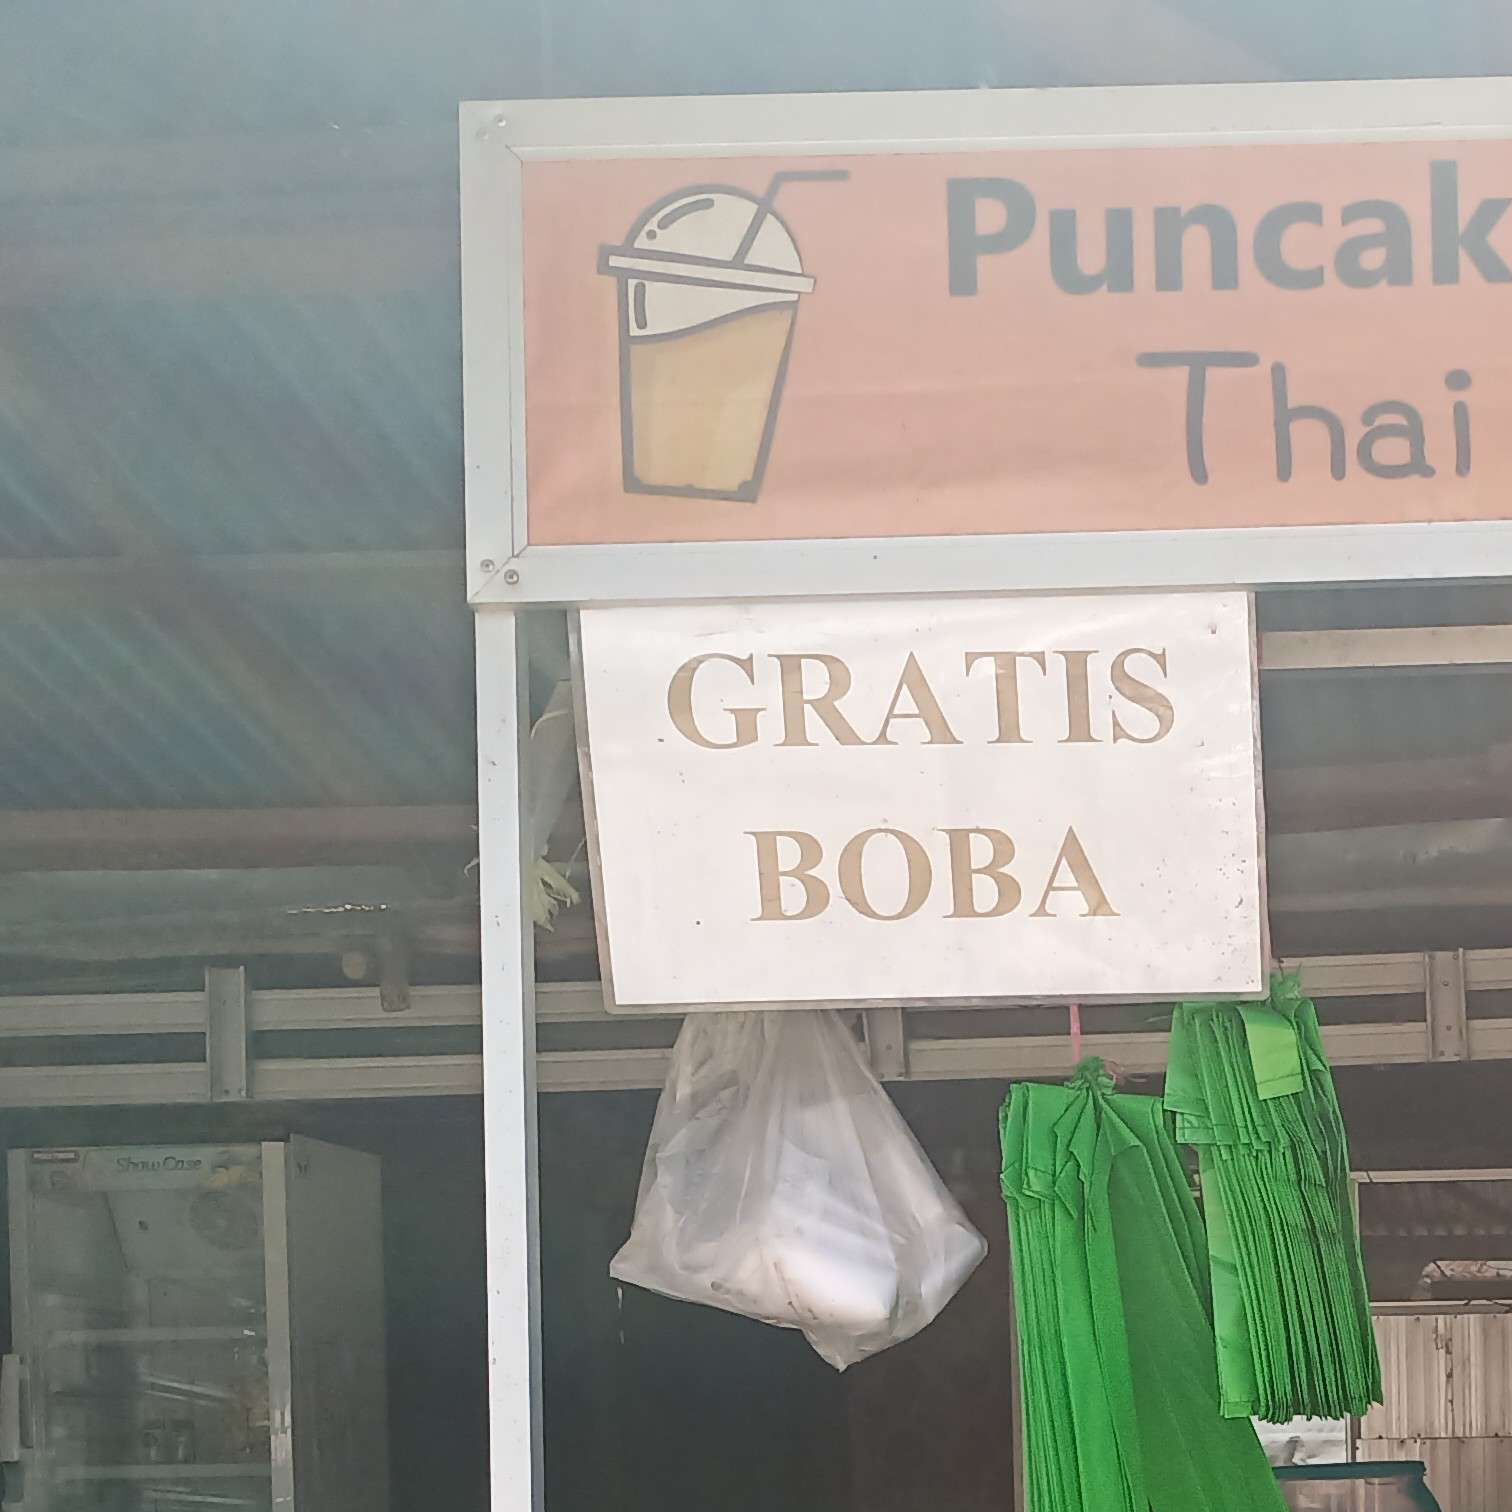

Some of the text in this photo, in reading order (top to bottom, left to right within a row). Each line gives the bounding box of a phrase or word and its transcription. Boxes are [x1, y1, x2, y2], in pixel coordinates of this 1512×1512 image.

[1136, 350, 1472, 486] Thai
[667, 647, 1175, 749] GRATIS
[744, 825, 1121, 921] BOBA
